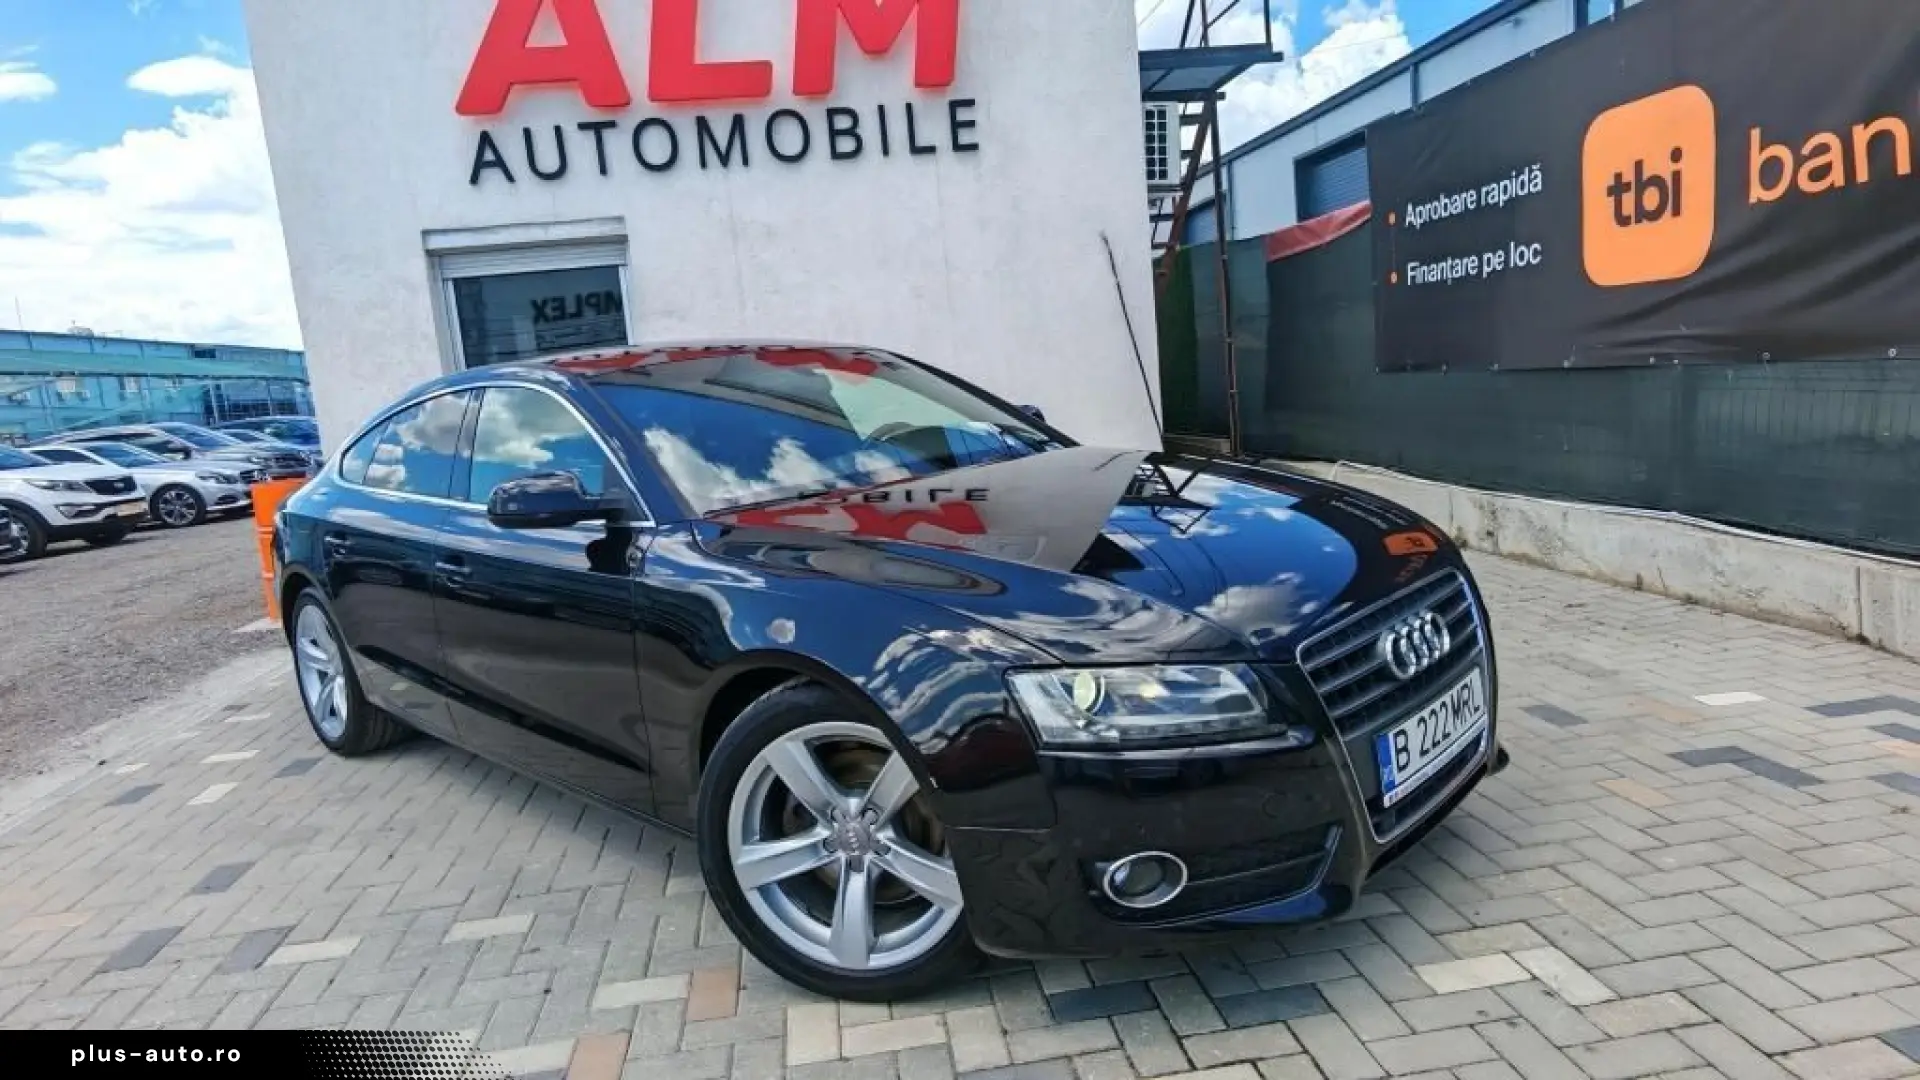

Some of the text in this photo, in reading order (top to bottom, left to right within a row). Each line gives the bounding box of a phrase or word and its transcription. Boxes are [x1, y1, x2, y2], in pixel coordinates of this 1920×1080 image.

[456, 0, 960, 116] ALM
[468, 98, 980, 186] AUTOMOBILE
[1606, 116, 1912, 228] tbi ban
[1404, 162, 1542, 230] Aprobare rapidă
[1407, 241, 1542, 286] Finanțare pe loc
[1393, 678, 1481, 772] B 222 MRL
